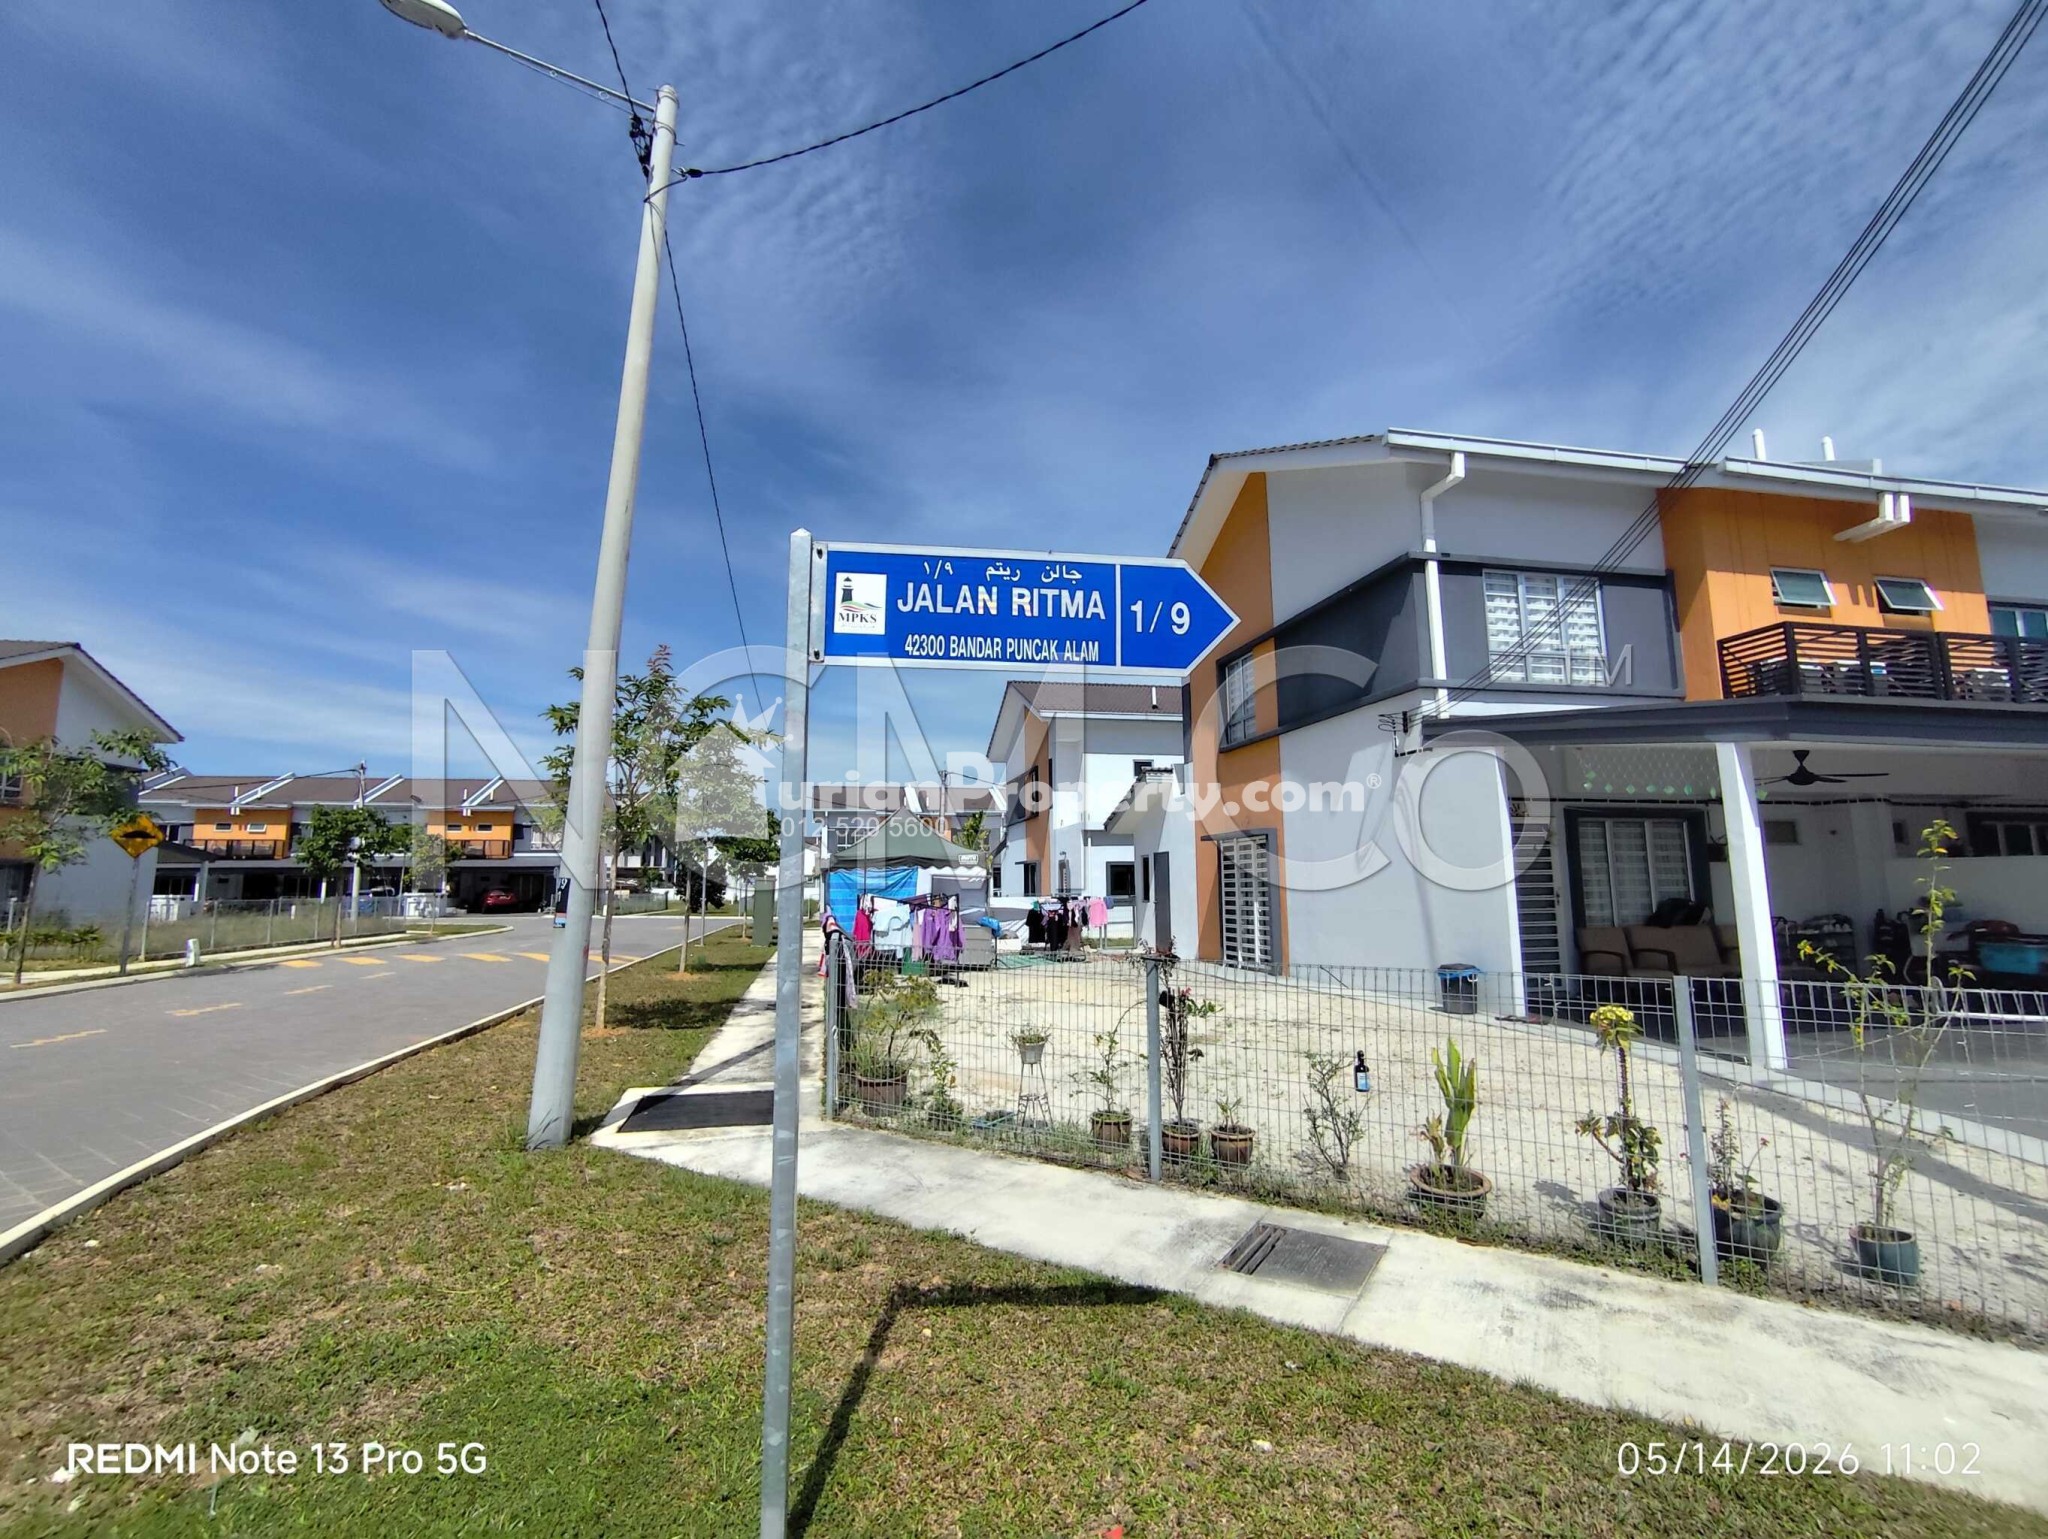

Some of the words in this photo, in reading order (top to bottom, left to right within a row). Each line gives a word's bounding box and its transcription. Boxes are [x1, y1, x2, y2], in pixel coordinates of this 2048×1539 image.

[897, 582, 998, 615] JALAN
[1011, 587, 1106, 620] RITMA
[838, 612, 877, 624] MPKS
[904, 633, 946, 656] 42300
[949, 635, 1003, 659] BANDAR
[1006, 637, 1059, 661] PUNCAK
[1063, 640, 1099, 662] ALAM
